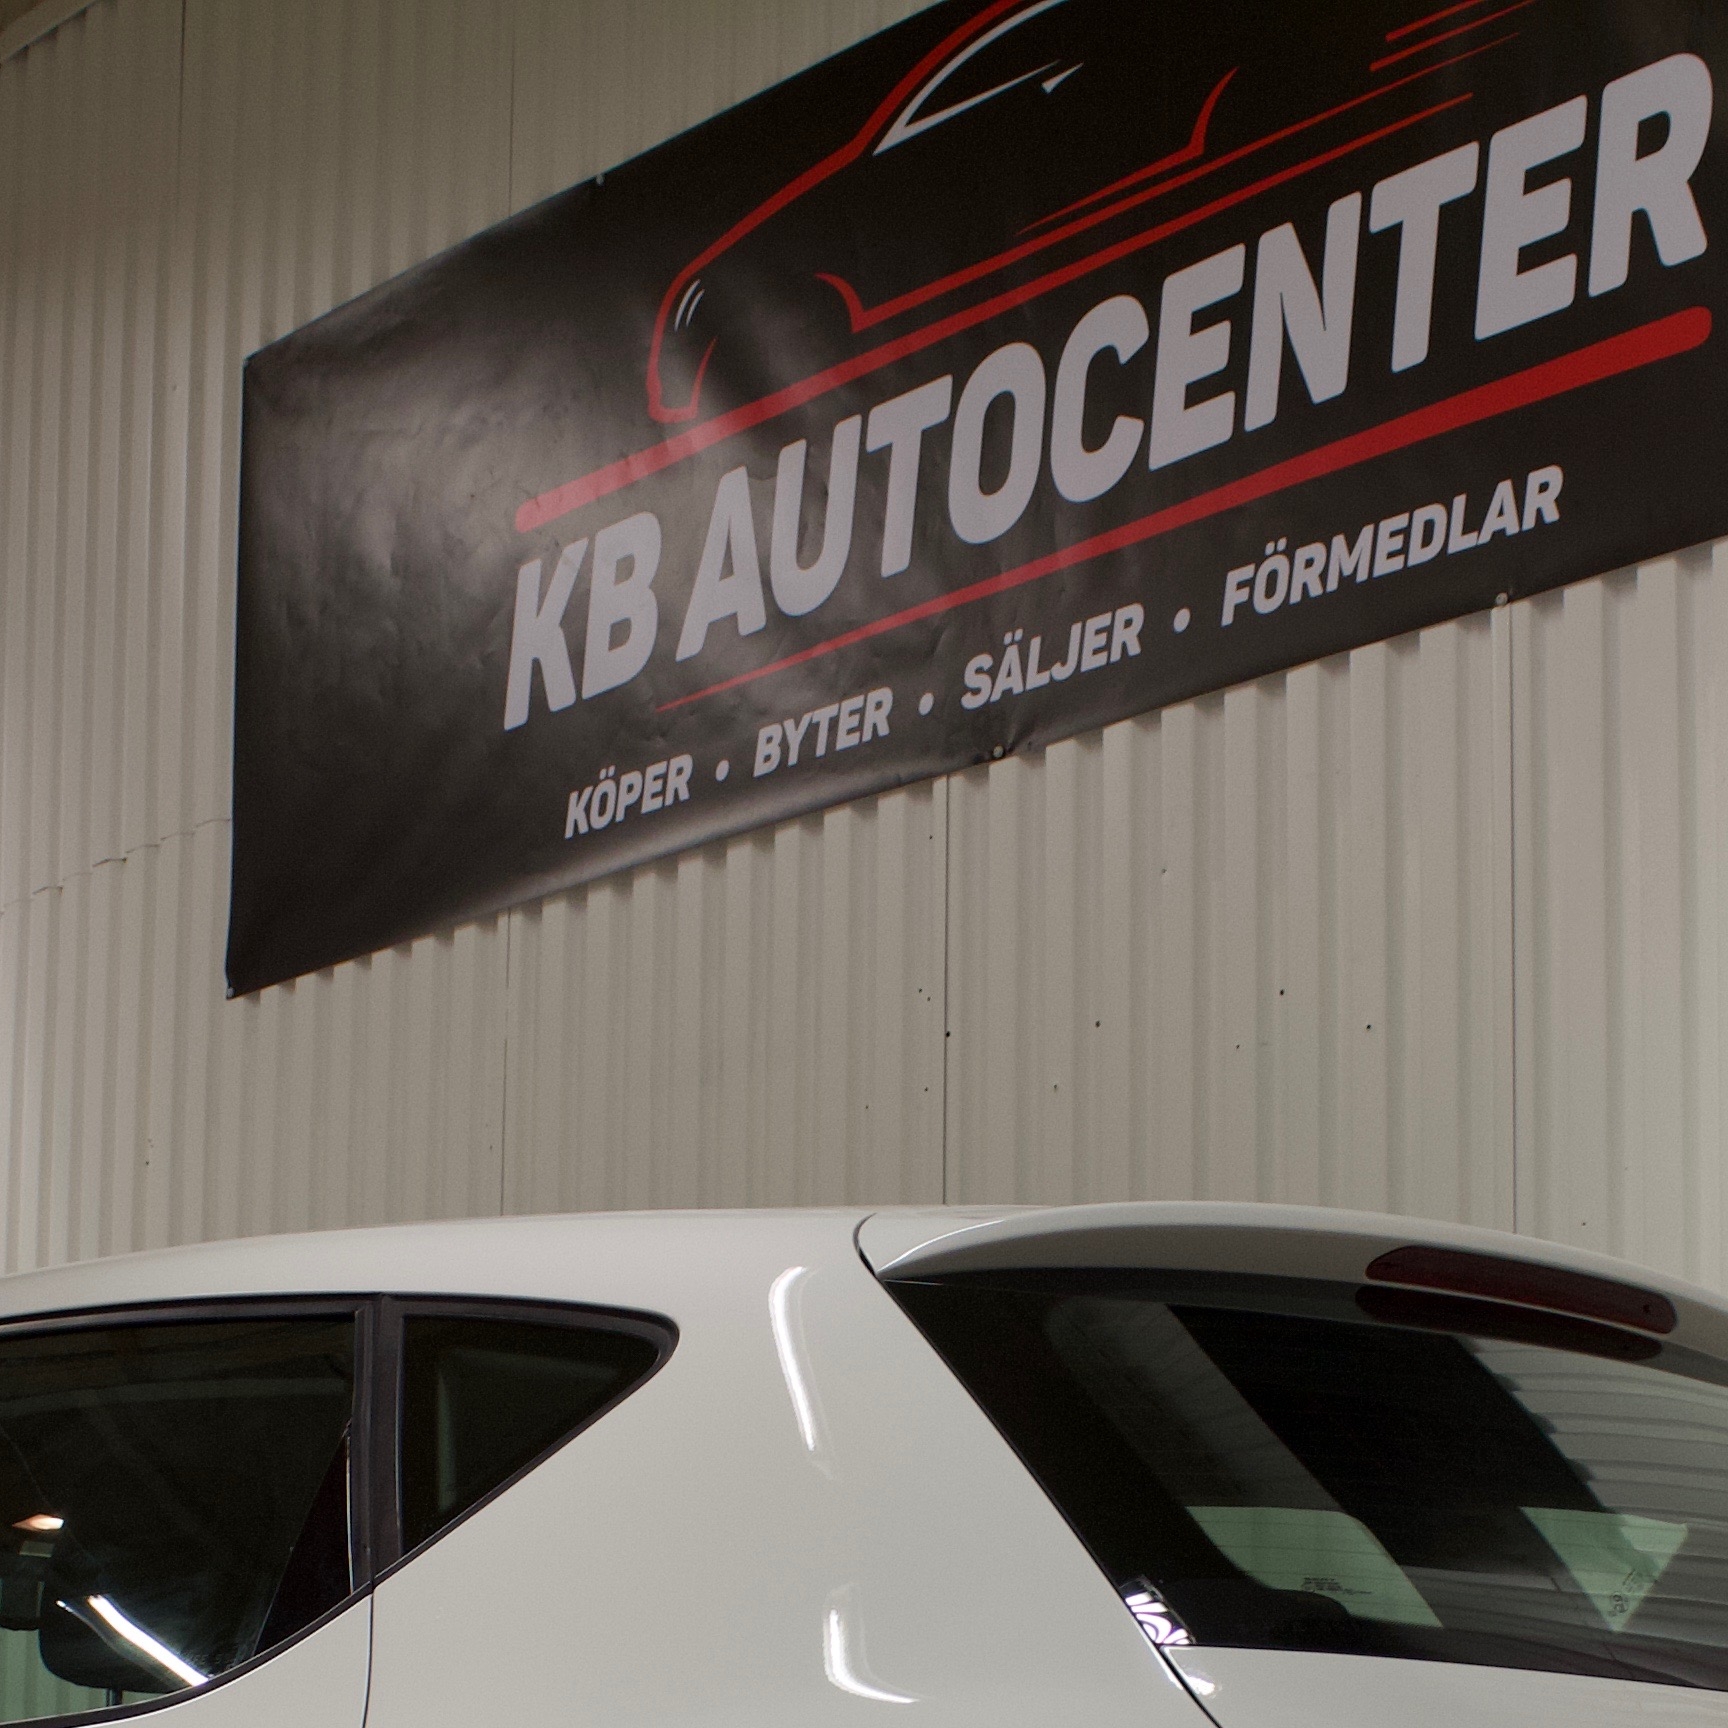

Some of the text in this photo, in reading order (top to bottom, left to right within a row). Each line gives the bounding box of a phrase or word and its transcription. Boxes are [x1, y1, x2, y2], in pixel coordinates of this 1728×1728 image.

[504, 53, 1714, 731] KB AUTOCENTER
[564, 464, 1565, 839] KÖPER BYTER SÄLJER FÖRMEDLAR
